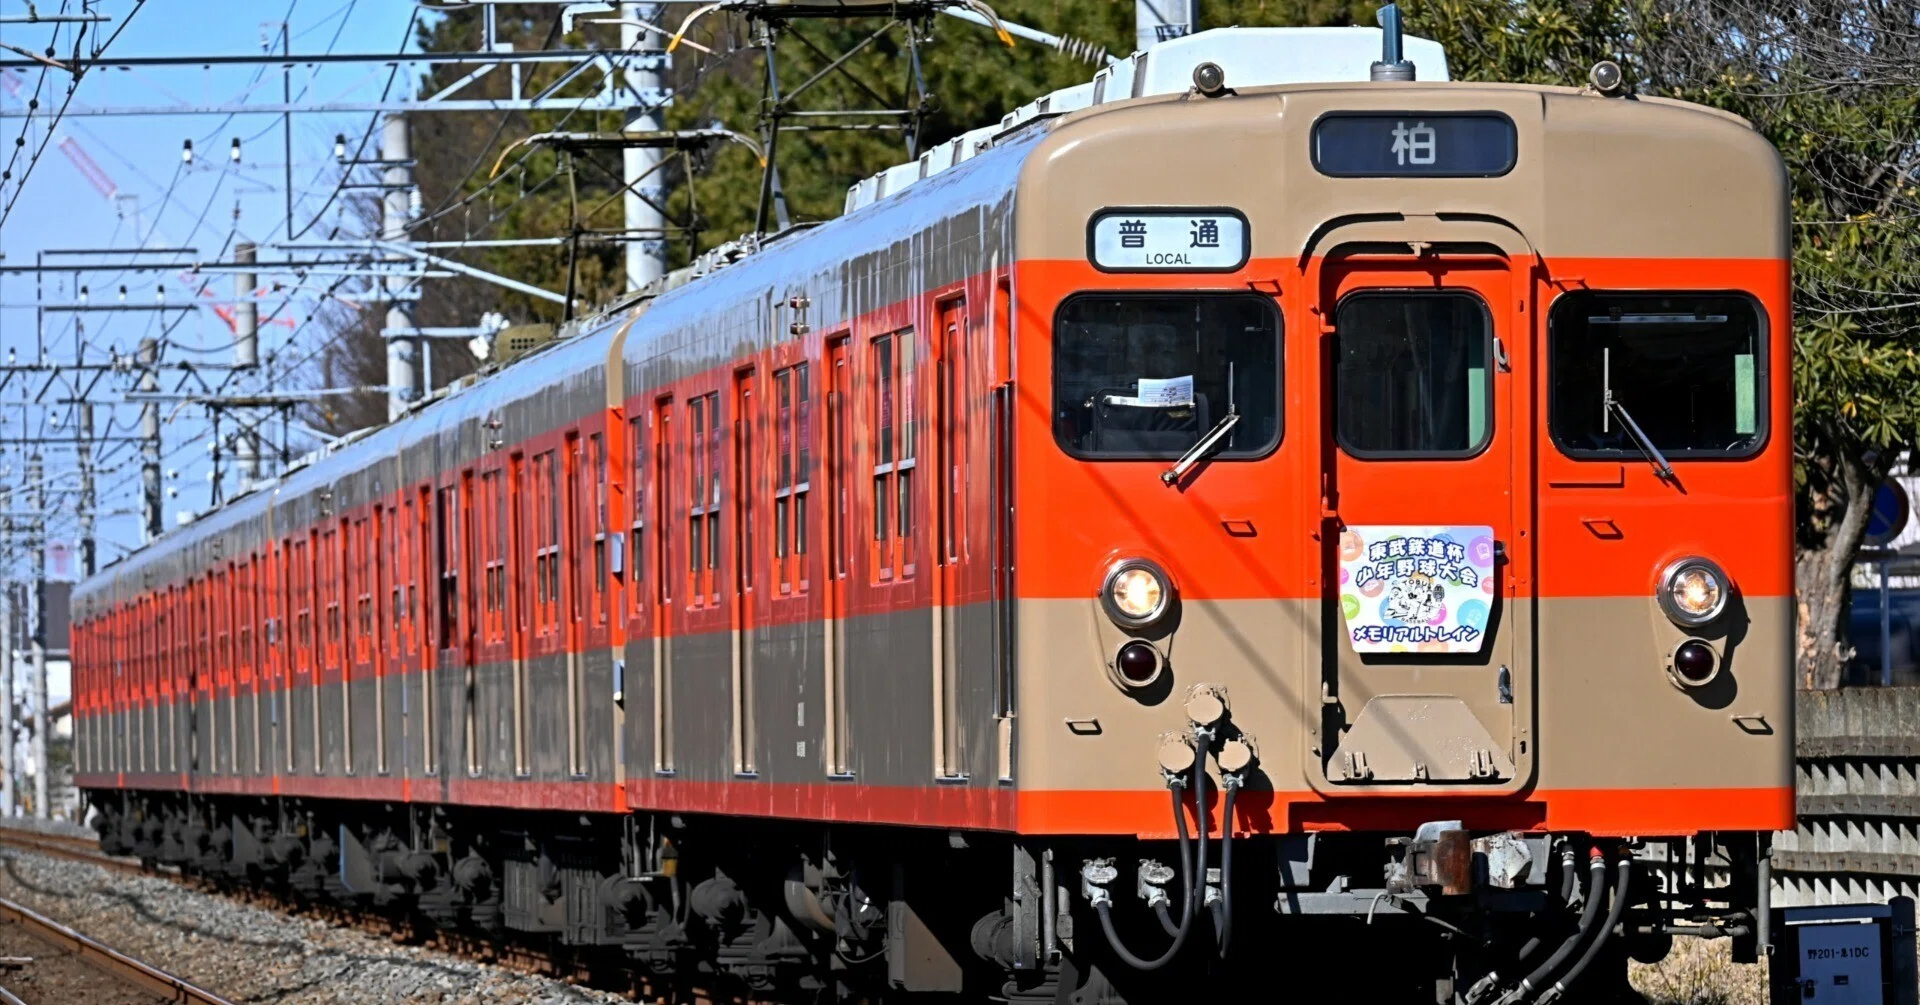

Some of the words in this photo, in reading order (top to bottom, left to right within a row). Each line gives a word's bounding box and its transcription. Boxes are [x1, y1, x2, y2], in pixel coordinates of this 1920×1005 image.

[1391, 121, 1436, 166] 柏
[1118, 219, 1220, 248] 普通
[1146, 253, 1192, 265] LOCAL
[1369, 537, 1465, 563] 東武鉄道杯
[1356, 558, 1478, 588] 少年野球大会
[1402, 579, 1428, 587] TOBU
[1353, 625, 1480, 643] メモリアルトレイン
